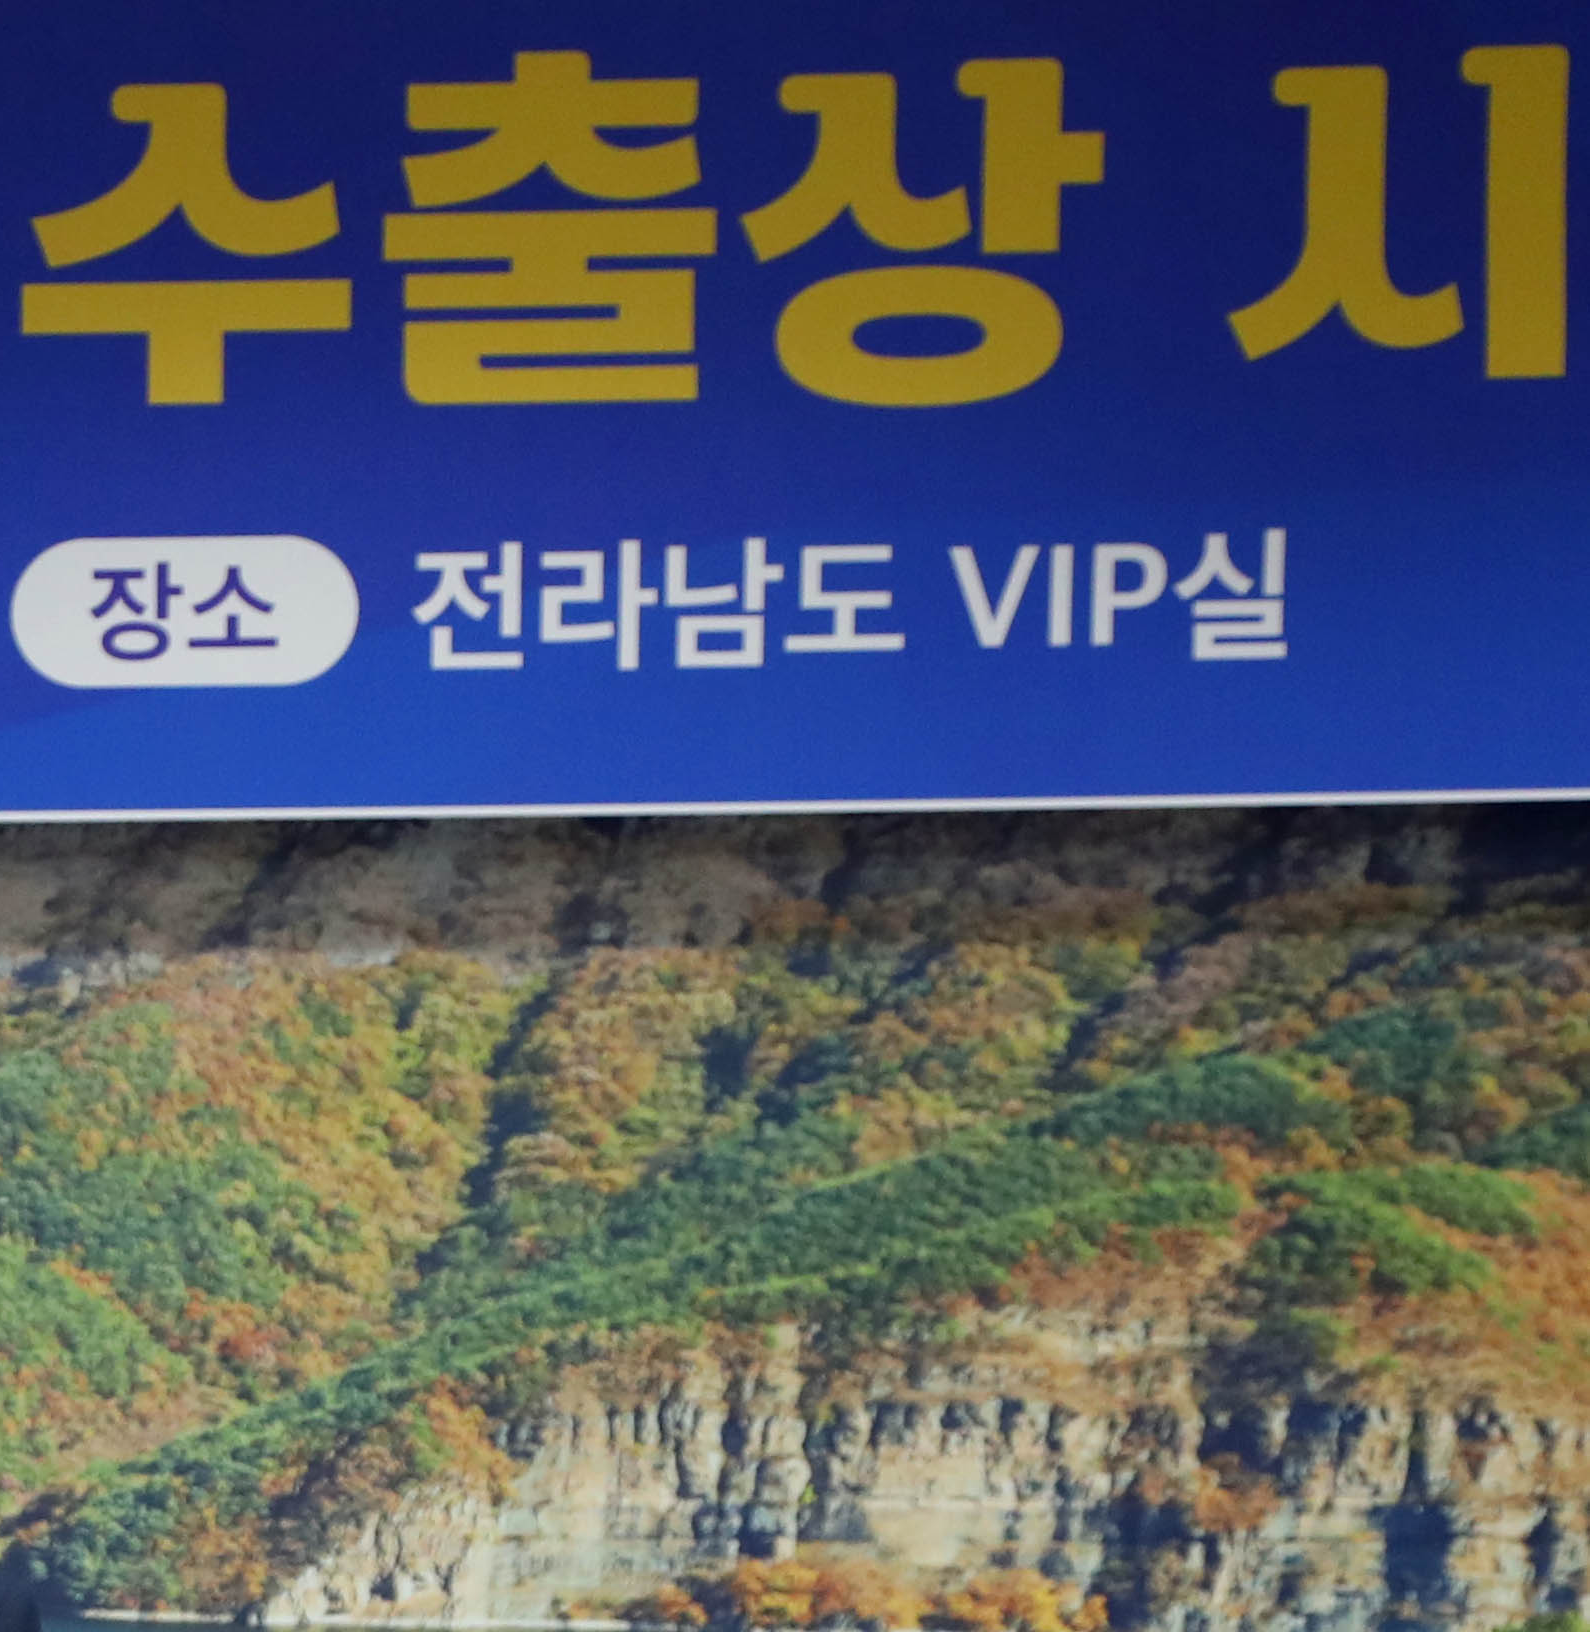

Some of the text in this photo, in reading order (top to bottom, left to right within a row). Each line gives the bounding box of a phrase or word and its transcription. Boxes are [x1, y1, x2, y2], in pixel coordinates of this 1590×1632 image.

[23, 52, 1103, 405] 수출상
[1231, 46, 1568, 376] 시
[92, 528, 1289, 671] 장소 전라남도 VIP실
